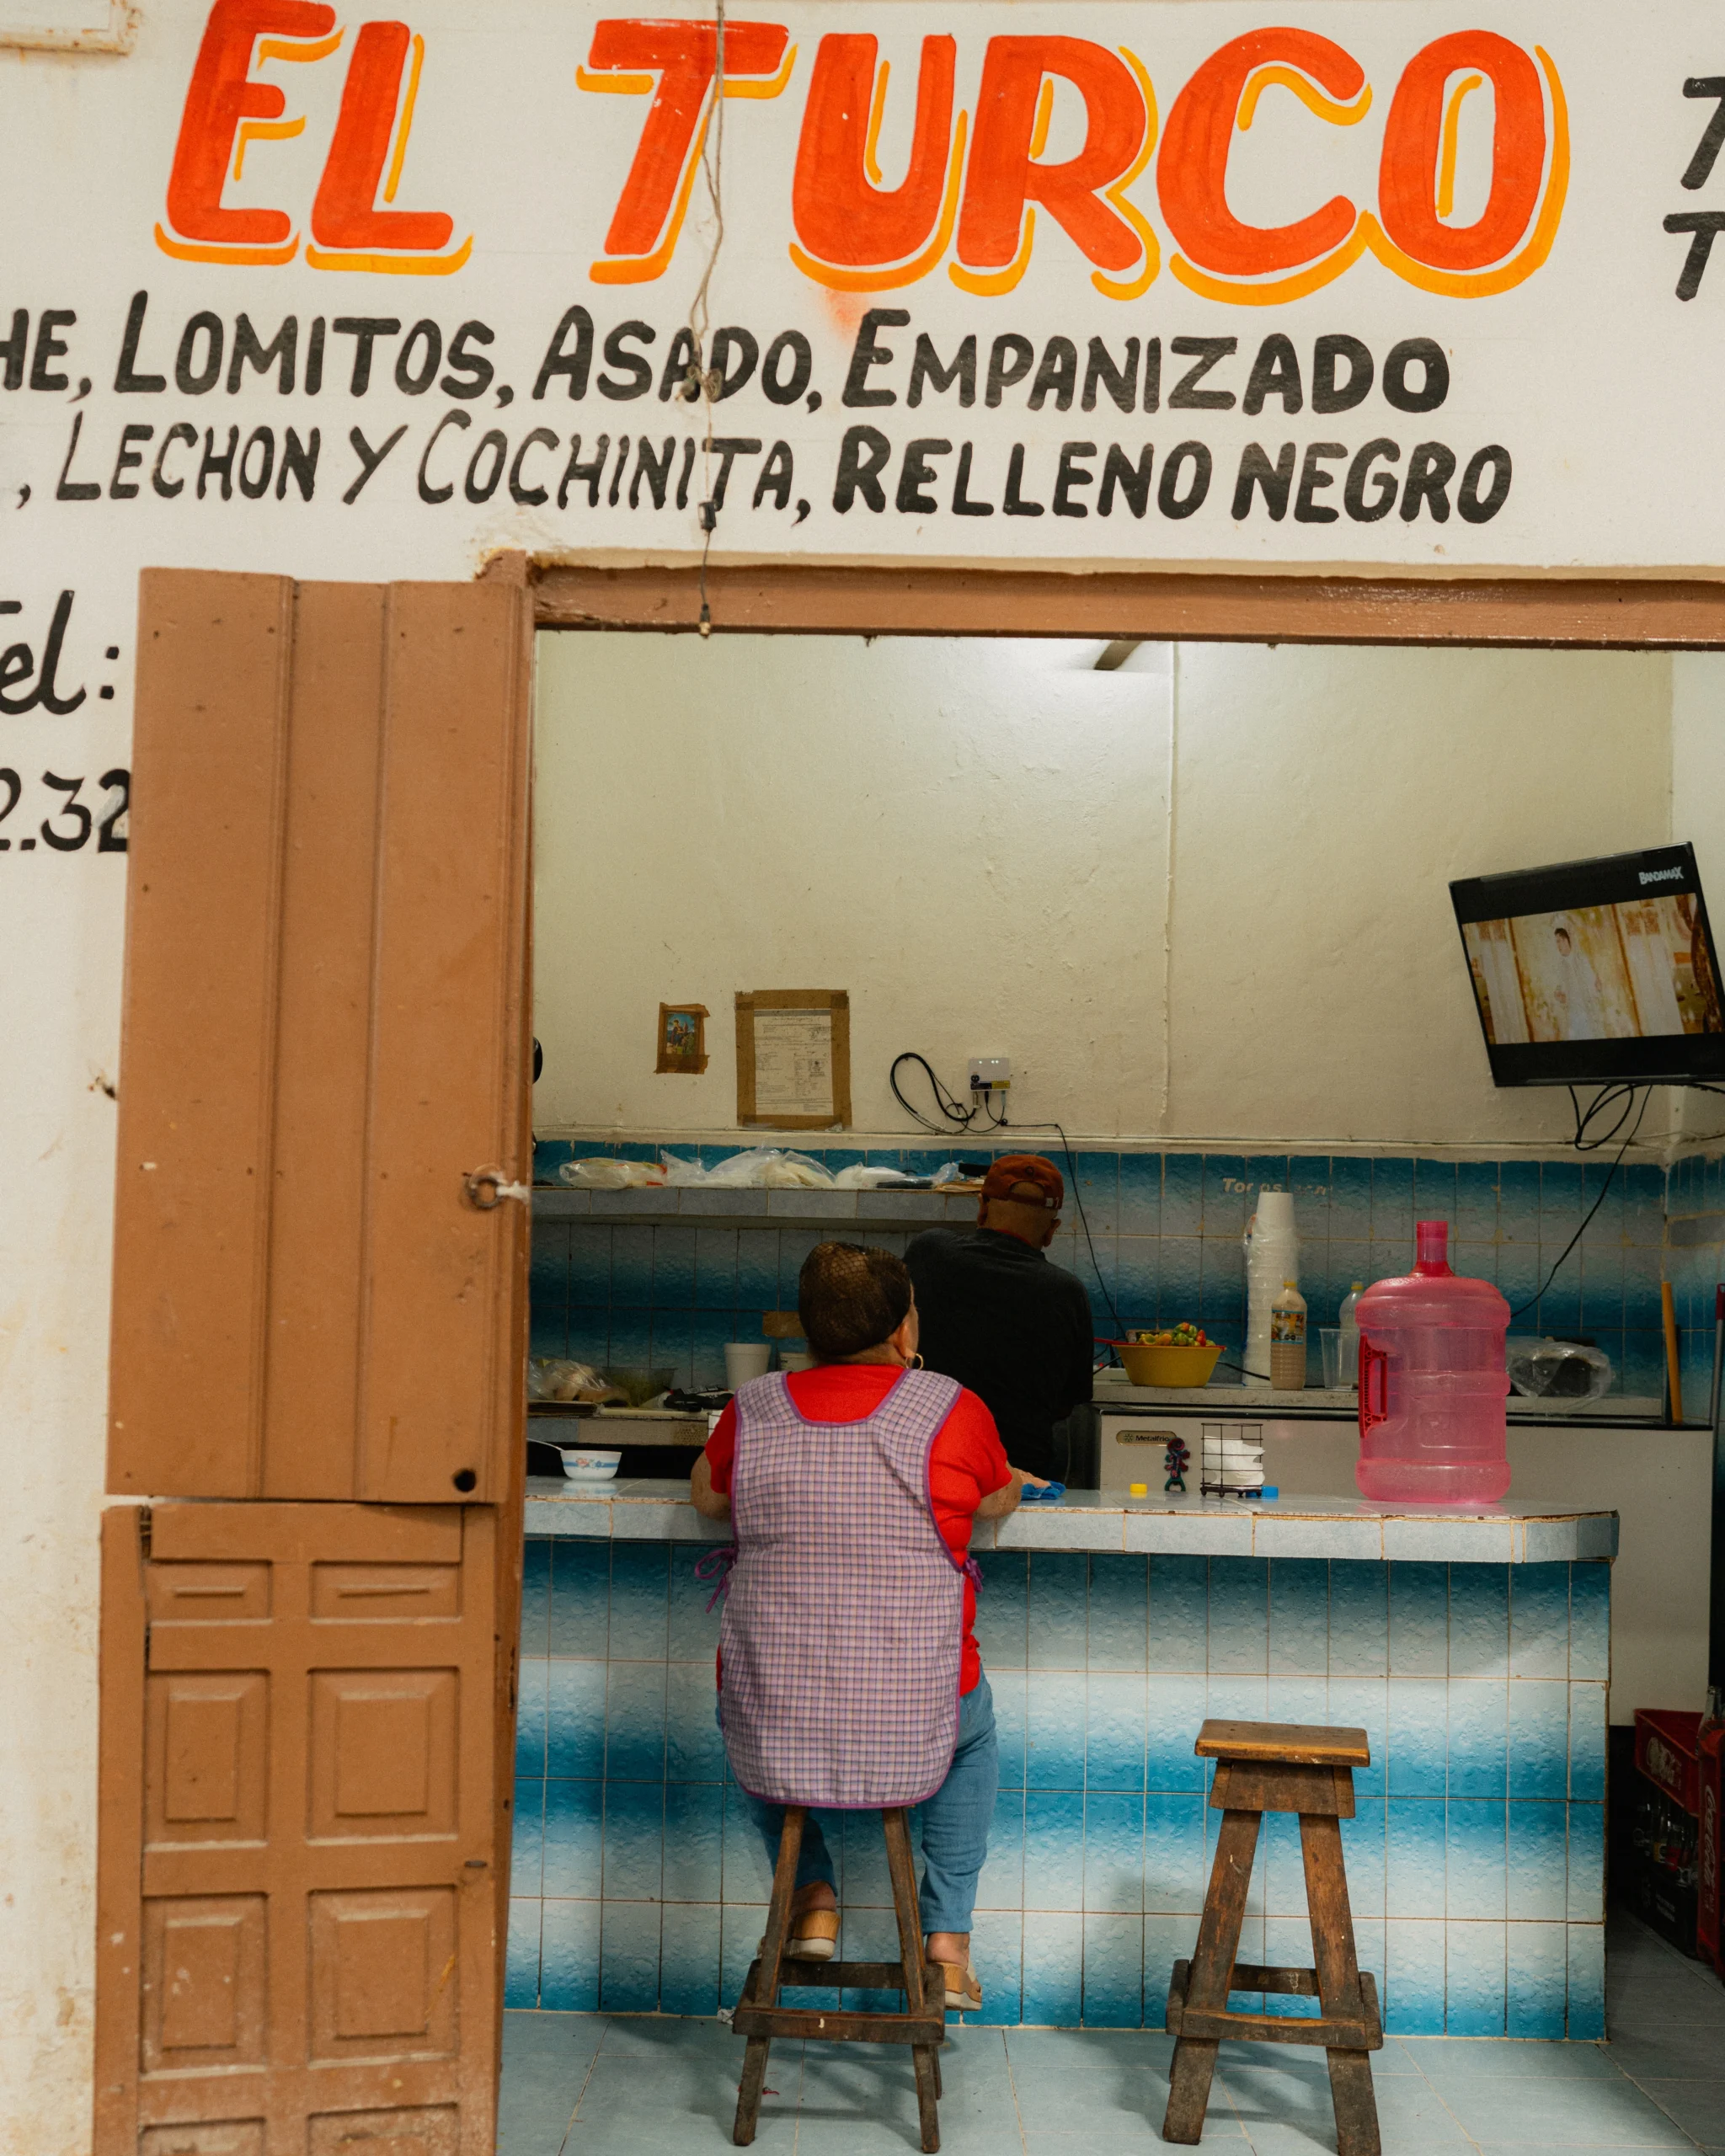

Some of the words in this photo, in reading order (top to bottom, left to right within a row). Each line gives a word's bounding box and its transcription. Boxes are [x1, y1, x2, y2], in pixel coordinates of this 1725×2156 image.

[154, 0, 473, 275] EL
[576, 19, 1570, 306] TURCO
[115, 291, 514, 408] LOMITOS,
[532, 305, 822, 413] ASADO,
[842, 309, 1450, 414] EMPANIZADO
[56, 411, 321, 502] LECHON
[343, 425, 409, 505] Y
[418, 409, 810, 524] COCHINITA,
[832, 425, 1212, 520] RELLENO
[1231, 438, 1512, 524] NEGRO
[1638, 866, 1685, 885] BANDAMAX
[1135, 1434, 1170, 1443] Metalfrio
